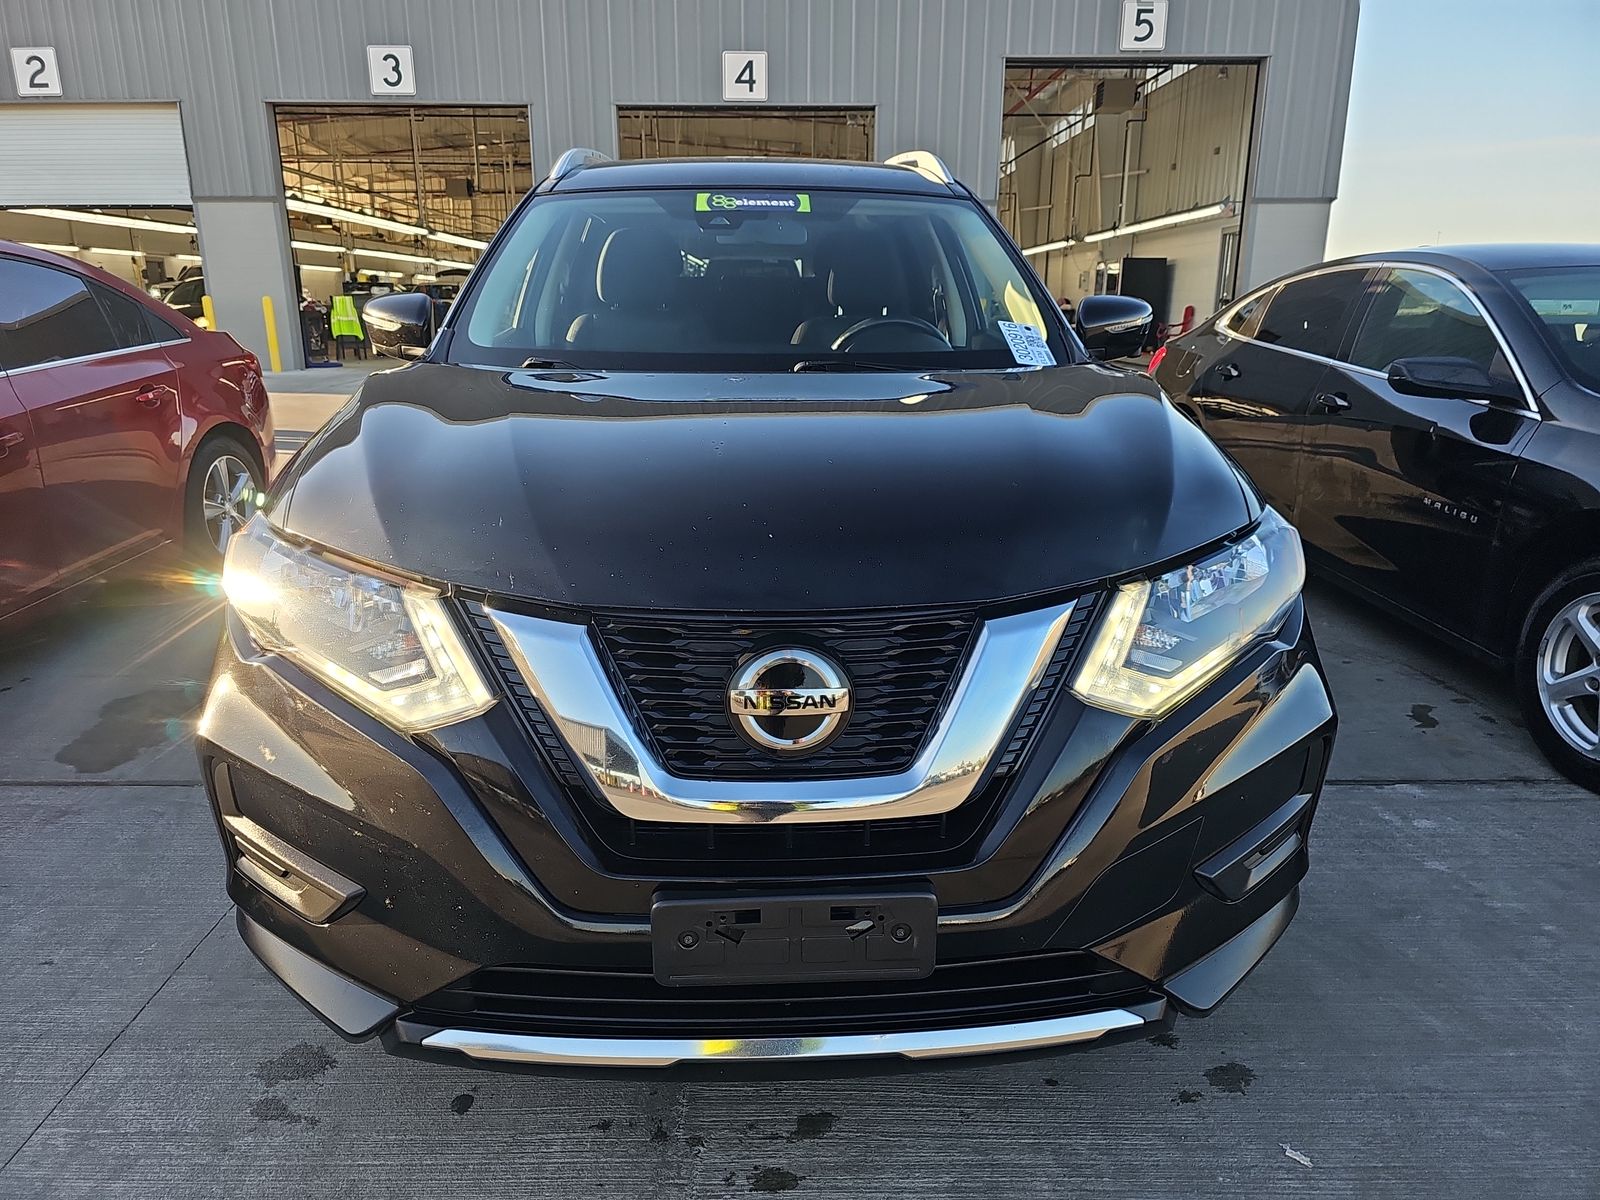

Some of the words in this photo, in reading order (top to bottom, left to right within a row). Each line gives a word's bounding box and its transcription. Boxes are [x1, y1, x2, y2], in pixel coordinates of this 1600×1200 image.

[1133, 8, 1154, 42] 5
[25, 55, 50, 88] 2
[382, 53, 402, 87] 3
[734, 59, 756, 92] 4
[735, 198, 795, 207] element
[1002, 322, 1034, 361] 3020916
[1423, 497, 1478, 524] MALIBU
[743, 693, 837, 711] NISSAN
